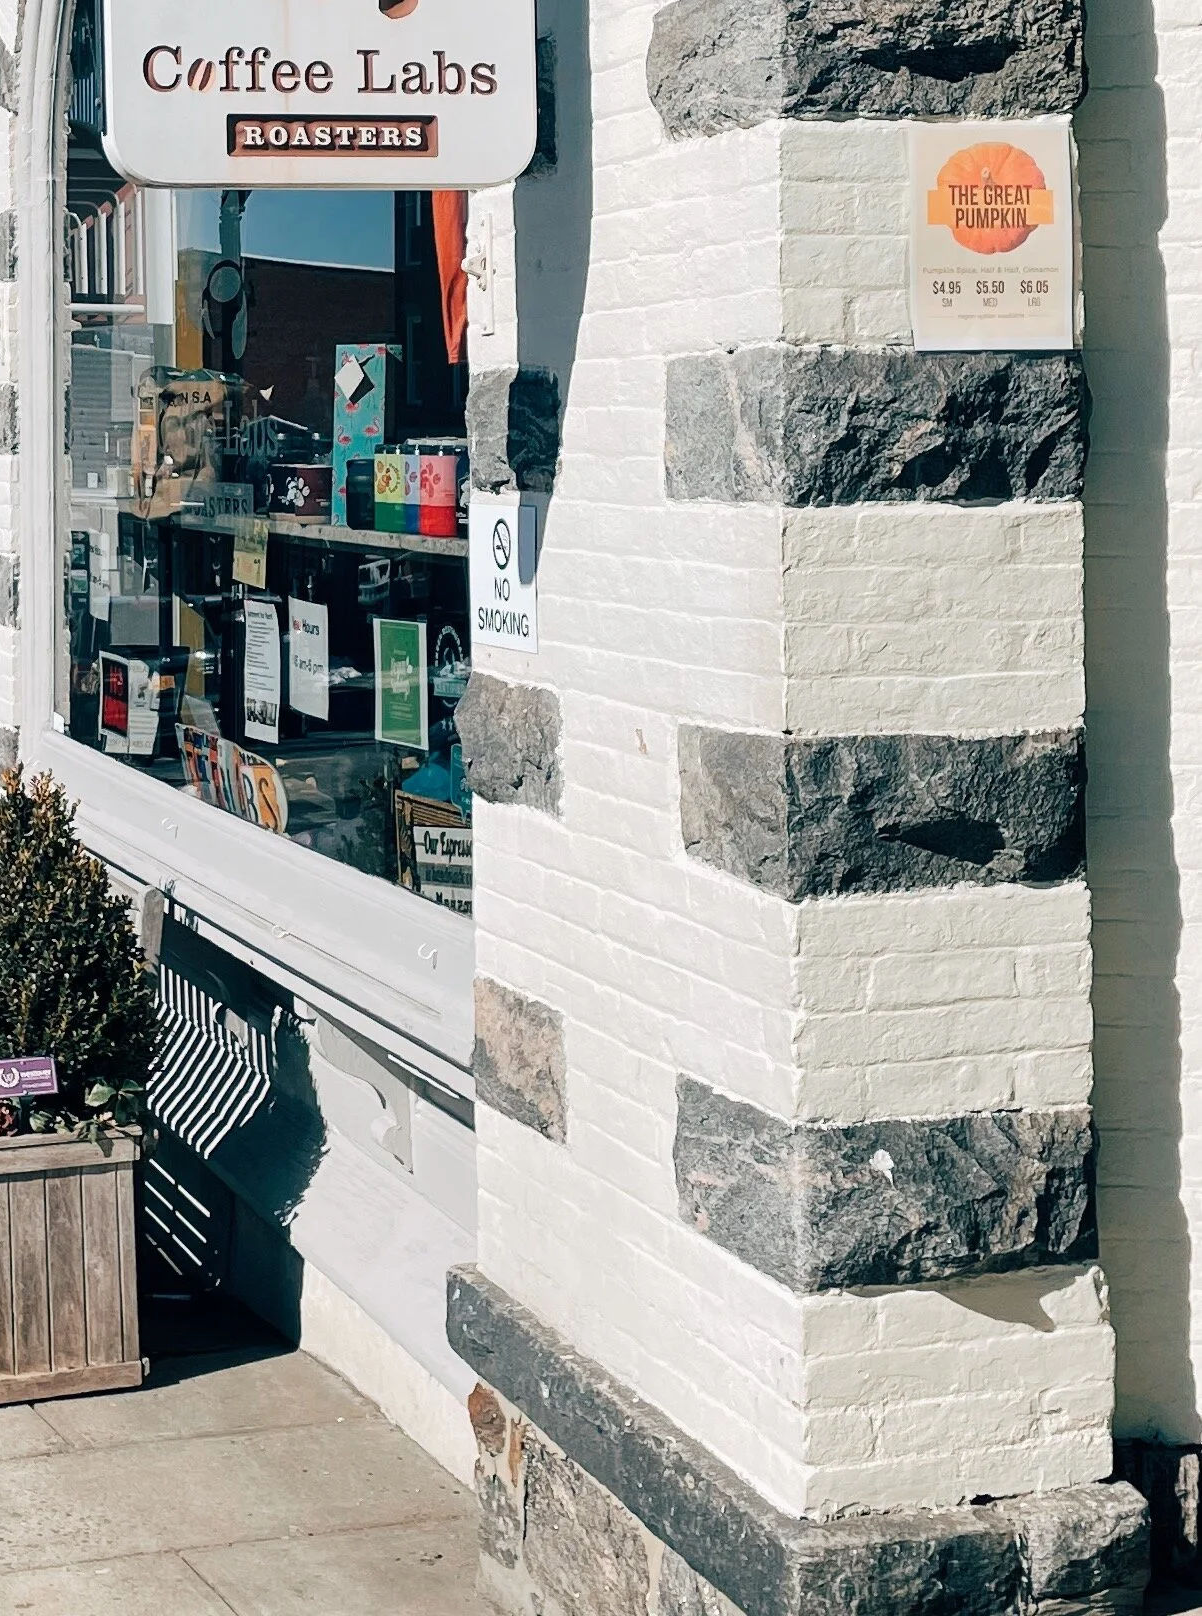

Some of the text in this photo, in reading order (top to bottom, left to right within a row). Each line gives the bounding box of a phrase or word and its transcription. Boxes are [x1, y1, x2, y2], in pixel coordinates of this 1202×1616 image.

[142, 45, 499, 96] Coffee Labs
[243, 125, 424, 148] ROASTERS
[948, 184, 1033, 206] THE GREAT
[955, 207, 1027, 229] PUMPKIN
[932, 279, 1049, 295] $4.95 $5.50 $6.05
[494, 576, 511, 602] NO
[477, 606, 530, 638] SMOKING
